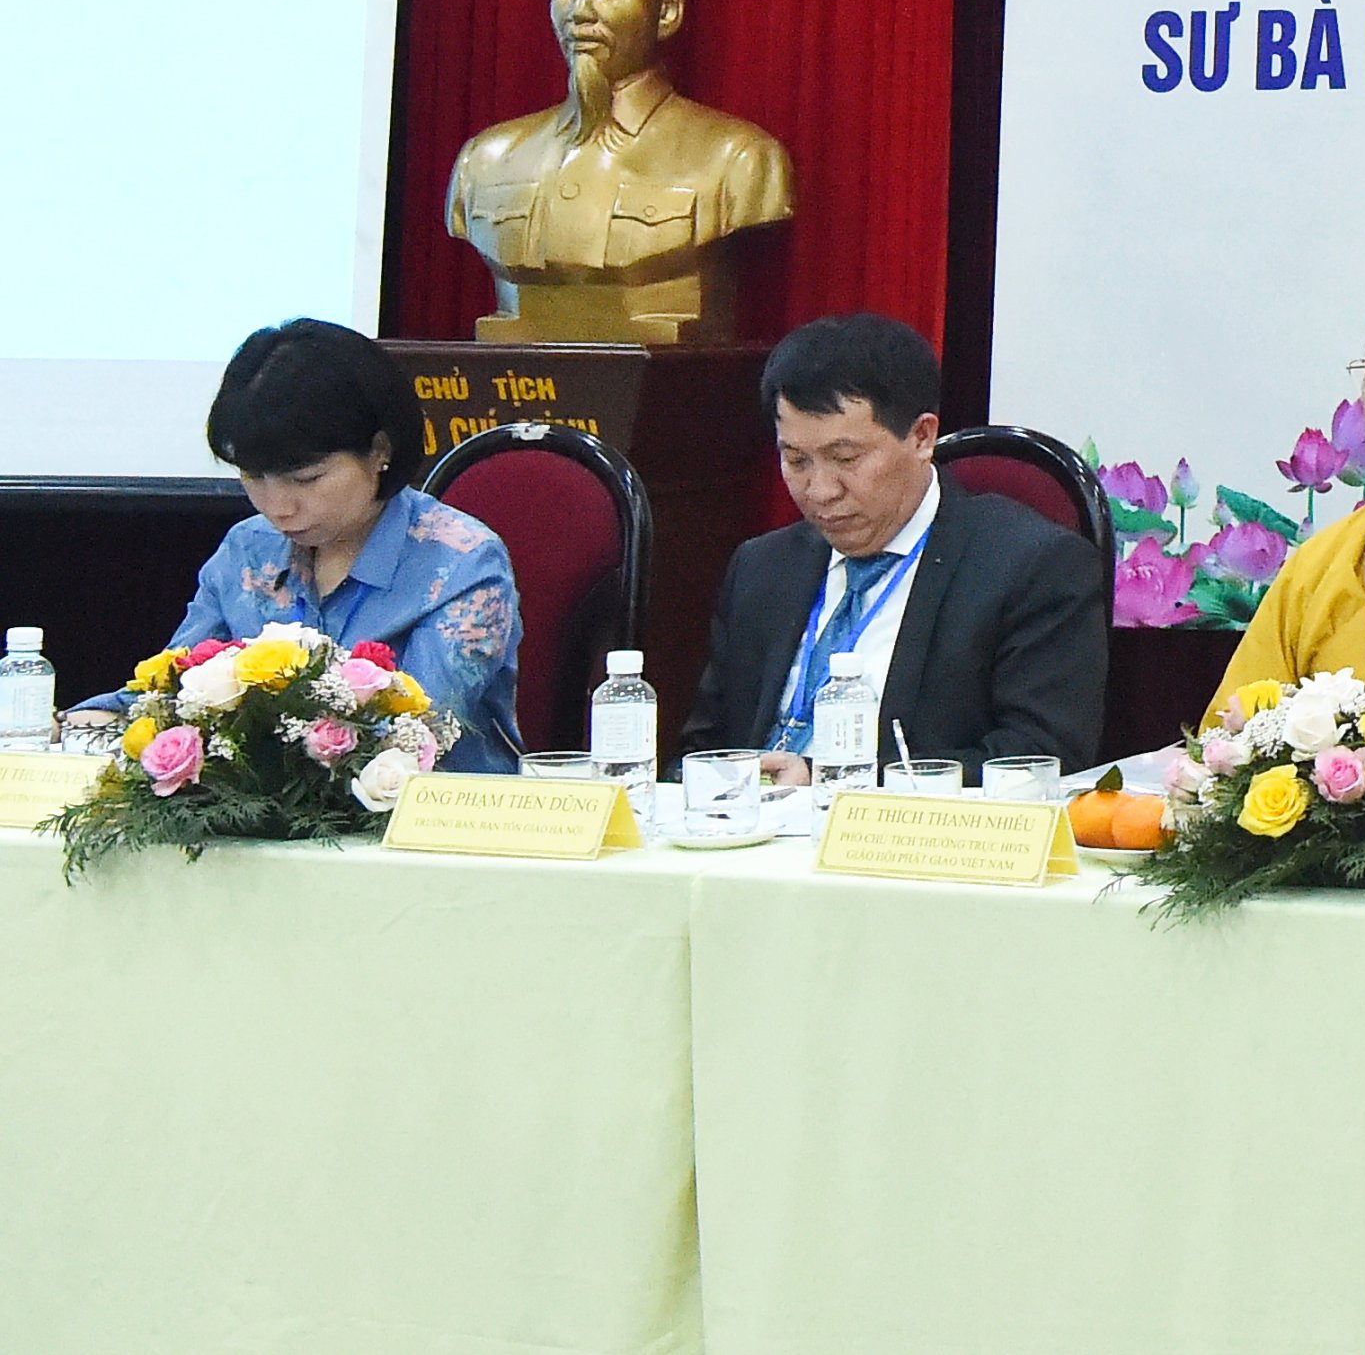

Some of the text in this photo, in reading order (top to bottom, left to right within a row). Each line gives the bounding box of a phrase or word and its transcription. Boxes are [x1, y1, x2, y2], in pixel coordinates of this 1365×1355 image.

[1141, 0, 1240, 92] SƯ
[414, 366, 557, 407] CHỦ TỊCH
[416, 786, 452, 805] ÔNG
[455, 791, 504, 810] PHẠM
[846, 806, 870, 821] HT.
[877, 807, 924, 825] THÍCH
[929, 811, 982, 829] THANH
